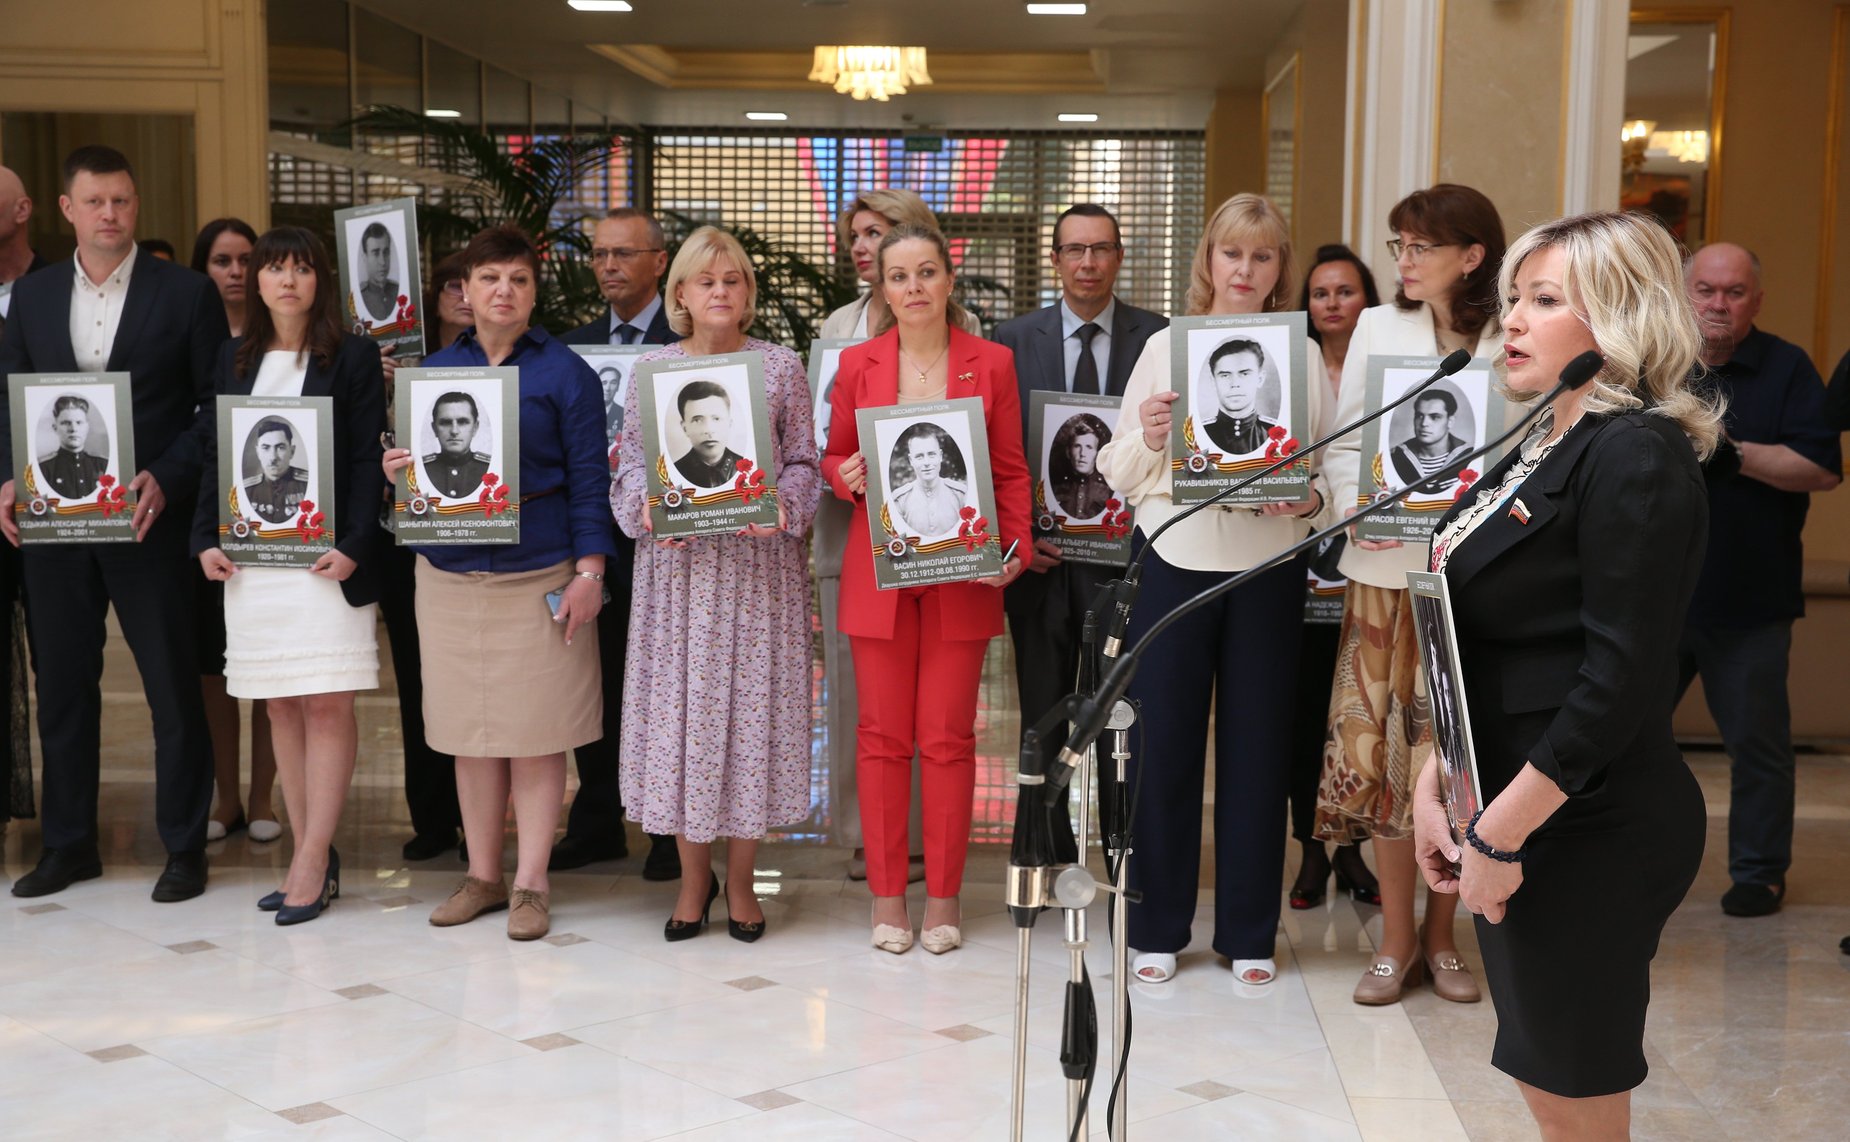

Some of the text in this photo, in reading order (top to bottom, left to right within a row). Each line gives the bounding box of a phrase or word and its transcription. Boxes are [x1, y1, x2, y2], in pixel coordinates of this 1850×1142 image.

[1174, 479, 1229, 487] РУКАВИШНИКОВ
[1262, 477, 1308, 485] ВАСИЛЬЕВИЧ
[668, 505, 761, 521] МАКАРОВ РОМАН ИВАНОВИЧ
[50, 520, 87, 528] АЛЕКСАНДР
[432, 519, 460, 528] АЛЕКСЕЙ
[1396, 516, 1428, 525] ЕВГЕНИЙ
[222, 543, 254, 551] БОЛДЫРЕВ
[255, 544, 293, 552] КОНСТАНТИН
[1062, 538, 1088, 547] АЛЬБЕРТ
[1089, 540, 1122, 550] ИВАНОВИЧ
[894, 554, 983, 570] ВАСИН НИКОЛАЙ ЕГОРОВИЧ
